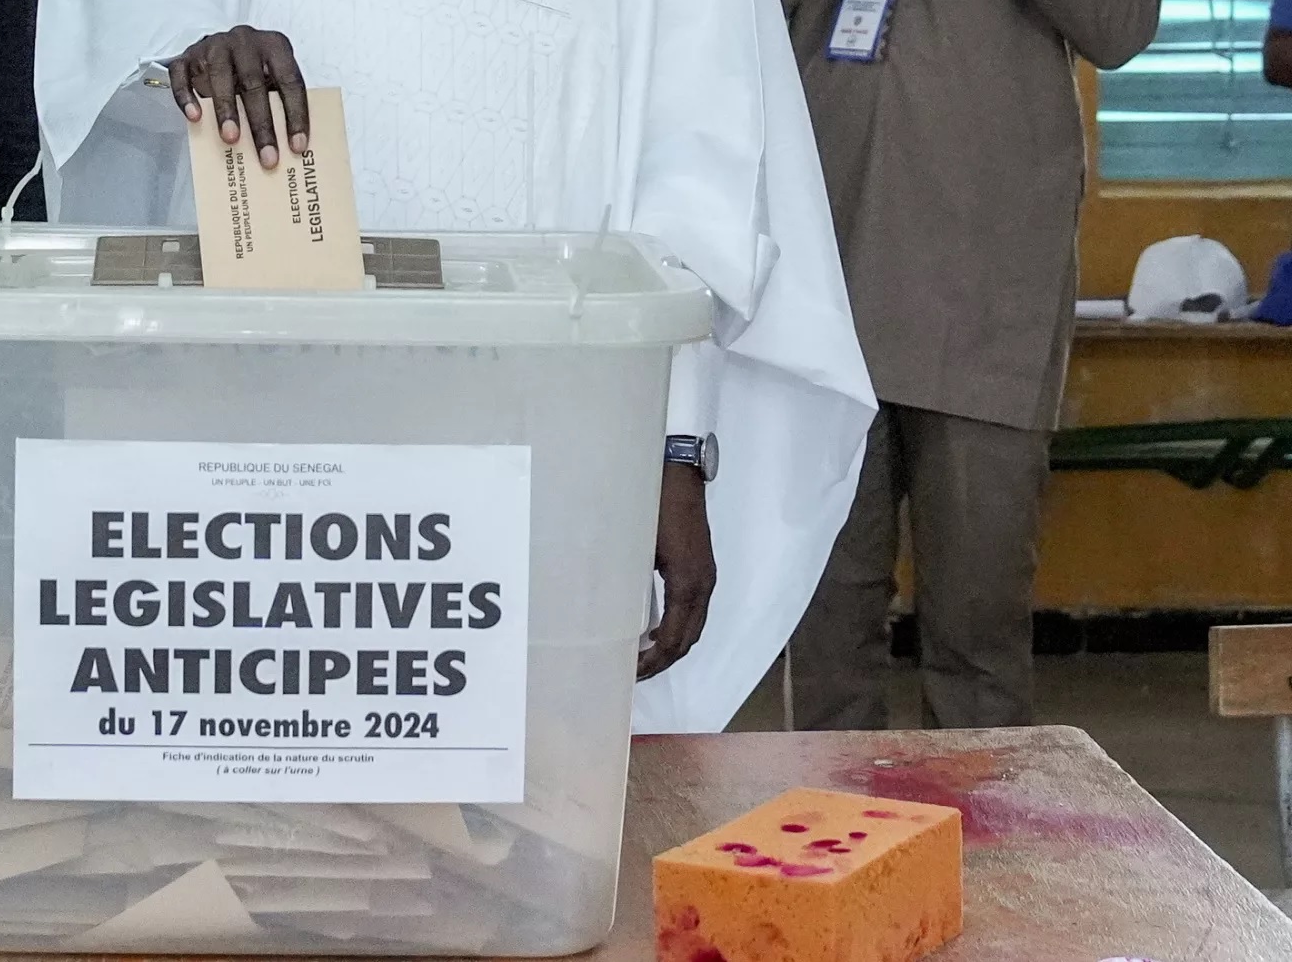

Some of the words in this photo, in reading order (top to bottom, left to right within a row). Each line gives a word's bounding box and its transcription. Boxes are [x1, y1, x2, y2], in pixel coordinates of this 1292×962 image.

[225, 147, 237, 187] SENEGAL
[236, 152, 244, 164] FOI
[229, 189, 238, 202] DU
[287, 167, 301, 224] ELECTIONS
[302, 149, 324, 242] LEGISLATIVES
[231, 205, 244, 259] REPUBLIQUE
[246, 241, 253, 252] UN
[198, 462, 271, 474] REPUBLIQUE
[274, 463, 290, 473] DU
[293, 463, 345, 474] SENEGAL
[211, 478, 224, 486] UN
[225, 478, 257, 486] PEUPLE
[92, 511, 452, 560] ELECTIONS
[40, 579, 502, 629] LEGISLATIVES
[70, 647, 468, 696] ANTICIPEES
[99, 708, 136, 736] du
[152, 710, 188, 736] 17
[199, 709, 352, 738] novembre
[364, 712, 440, 738] 2024
[162, 751, 191, 761] Fiche
[194, 751, 255, 762] d'indication
[258, 752, 270, 762] de
[273, 753, 283, 762] la
[285, 754, 319, 762] nature
[321, 753, 335, 762] du
[338, 753, 374, 763] scrutin
[232, 765, 262, 774] coller
[265, 767, 281, 775] sur
[284, 766, 314, 775] l'urne
